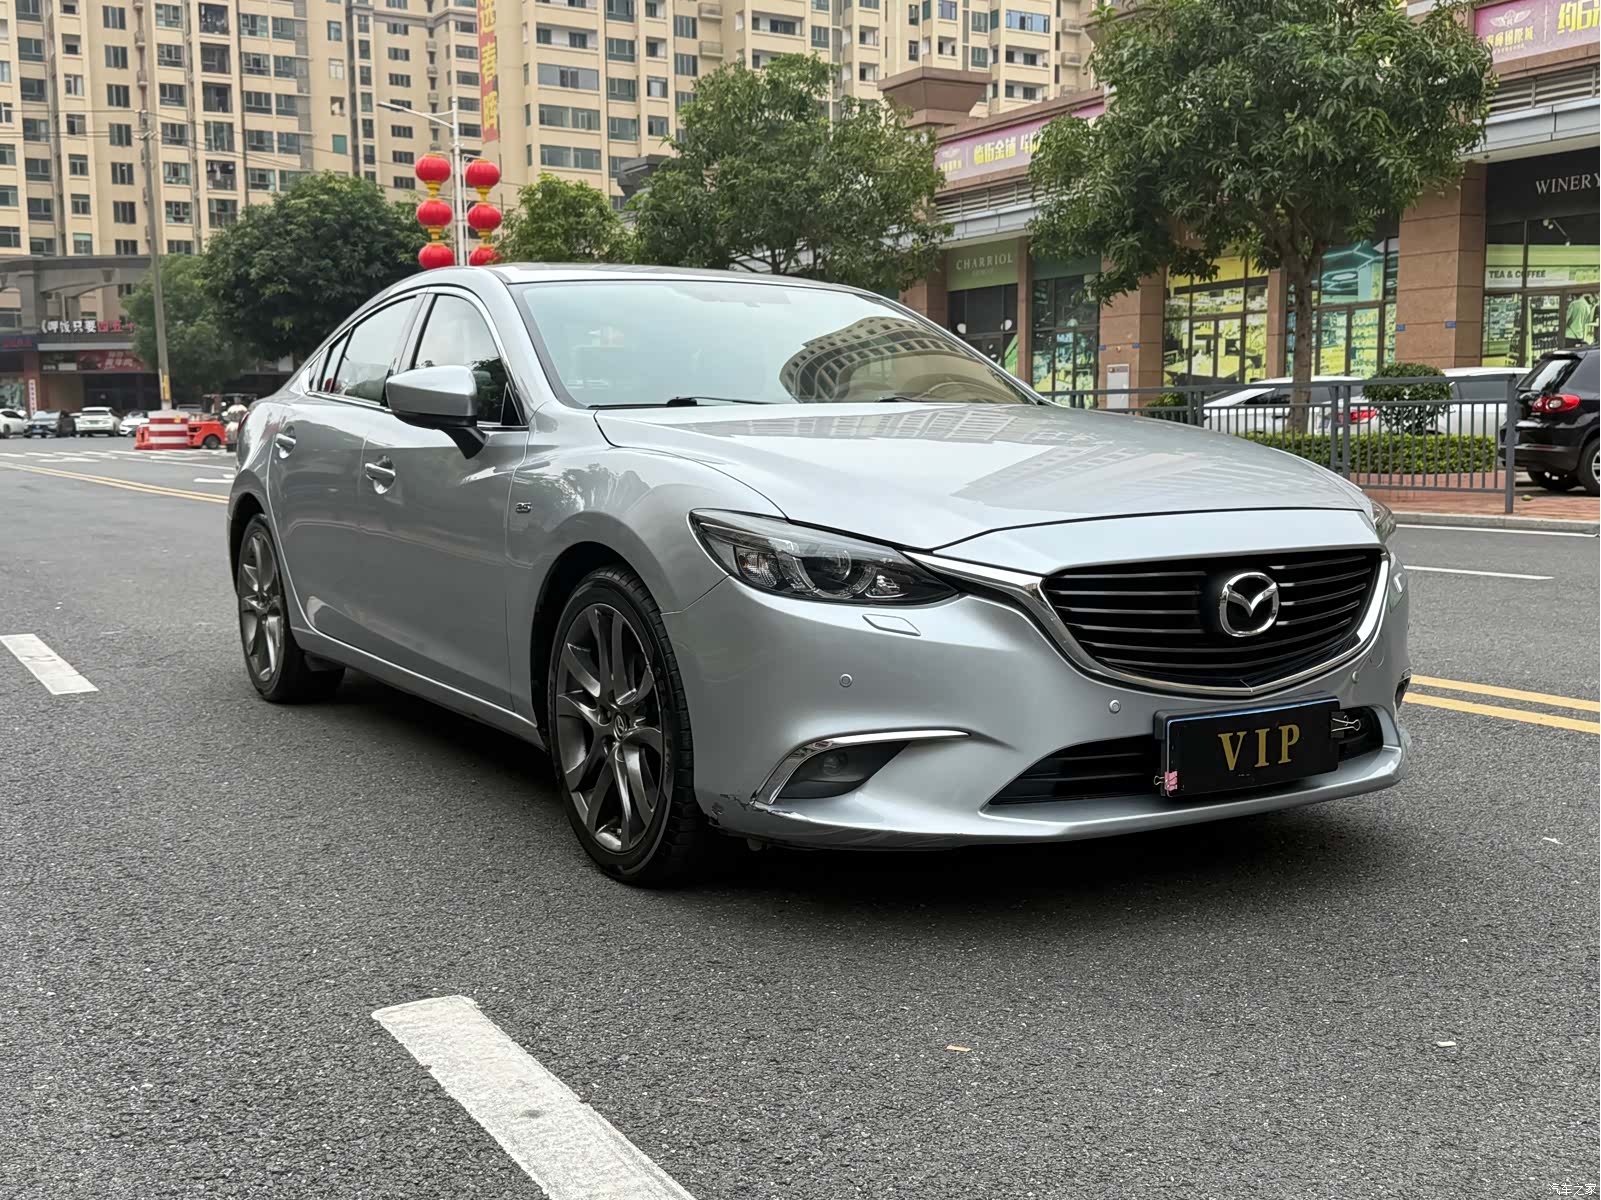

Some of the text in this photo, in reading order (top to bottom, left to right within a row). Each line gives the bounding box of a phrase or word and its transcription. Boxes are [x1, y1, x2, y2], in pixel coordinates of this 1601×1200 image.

[956, 253, 1013, 270] CHARRIOL
[1488, 270, 1505, 279] TEA
[1515, 270, 1546, 278] CFFEE
[1217, 724, 1300, 771] VIP
